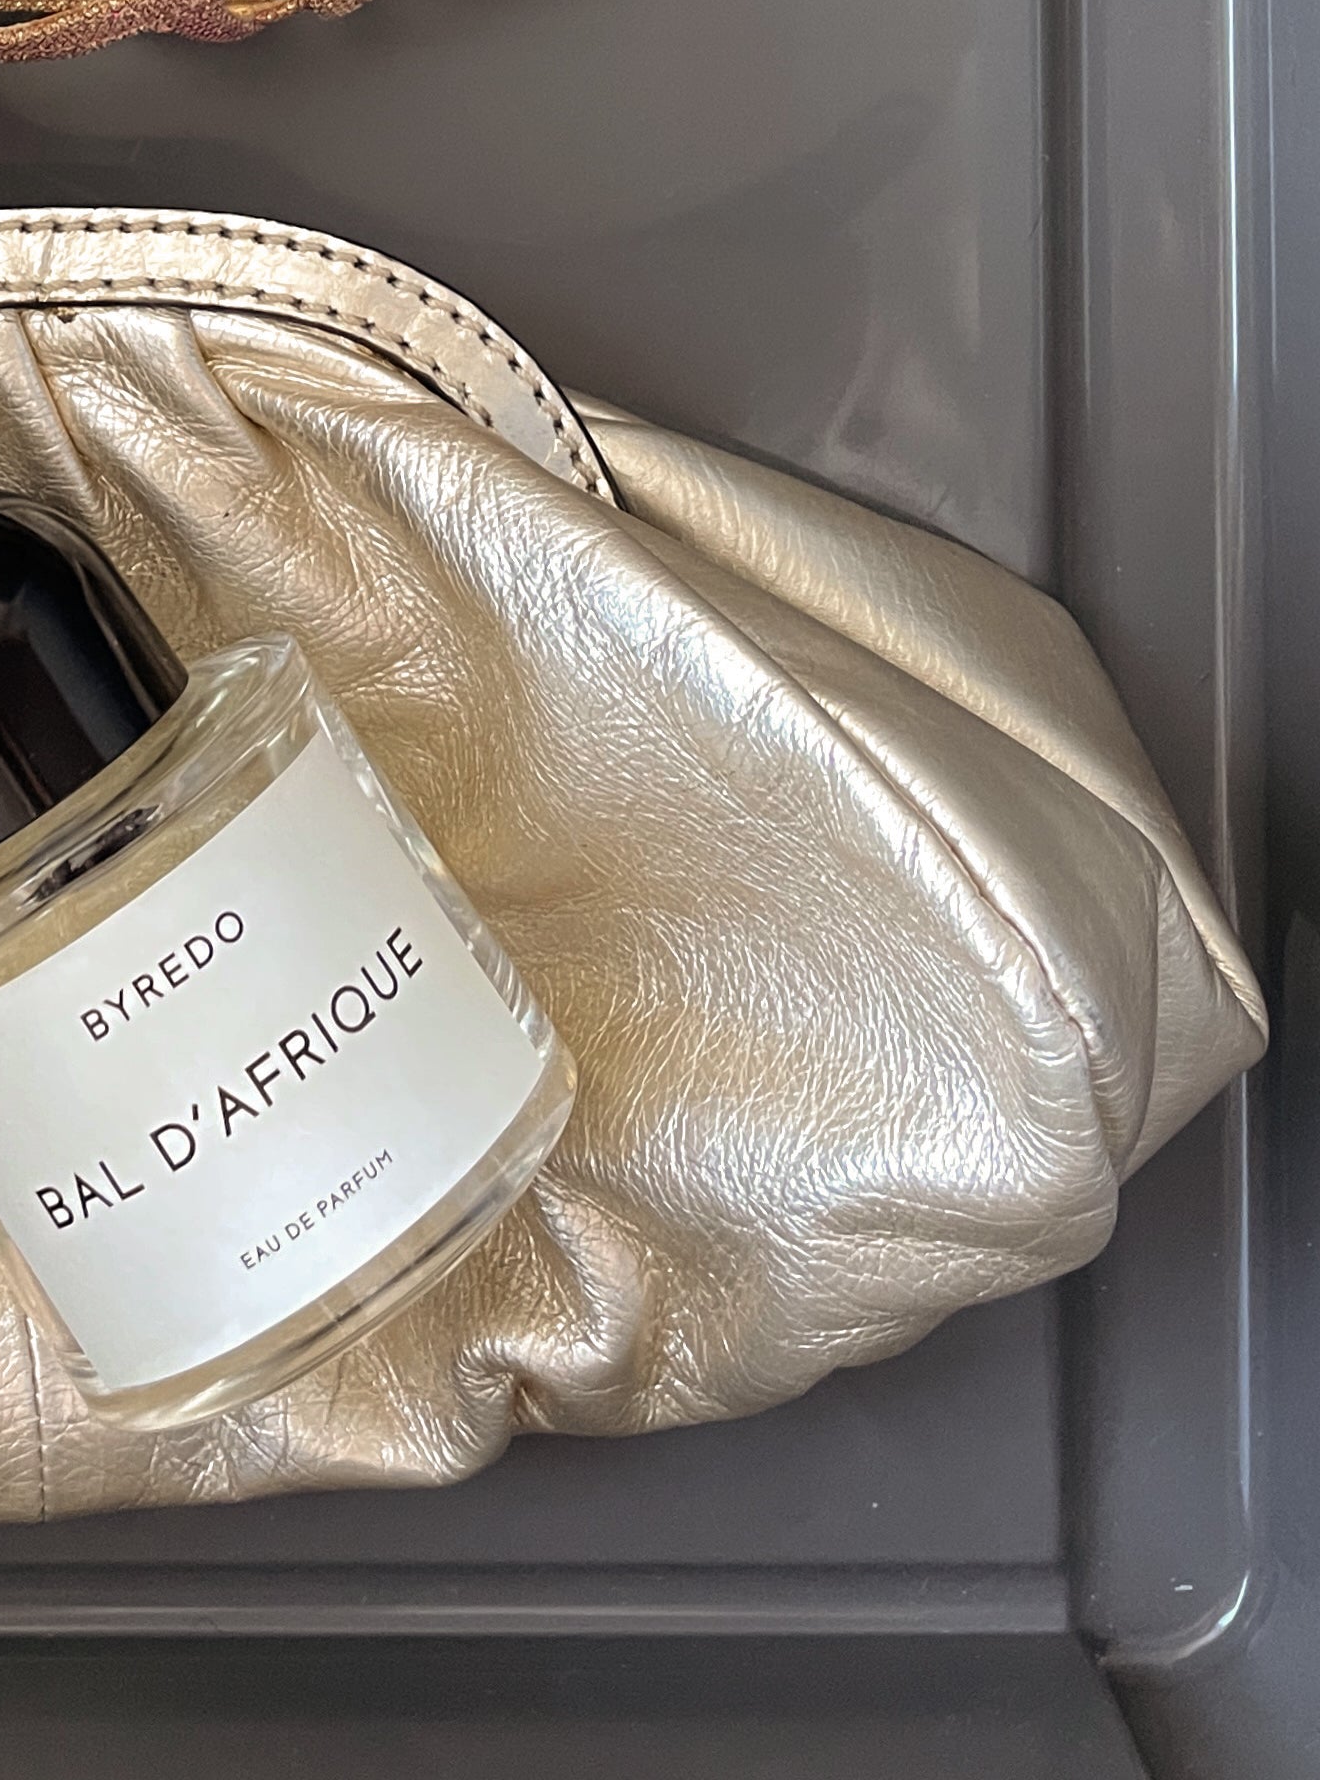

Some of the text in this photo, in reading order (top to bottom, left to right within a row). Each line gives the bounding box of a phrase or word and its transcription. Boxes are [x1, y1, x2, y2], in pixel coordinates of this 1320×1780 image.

[80, 910, 245, 1042] BYREDO
[35, 926, 424, 1230] BAL D'AFRIQUE
[240, 1149, 394, 1271] EAU DE PARFUM
